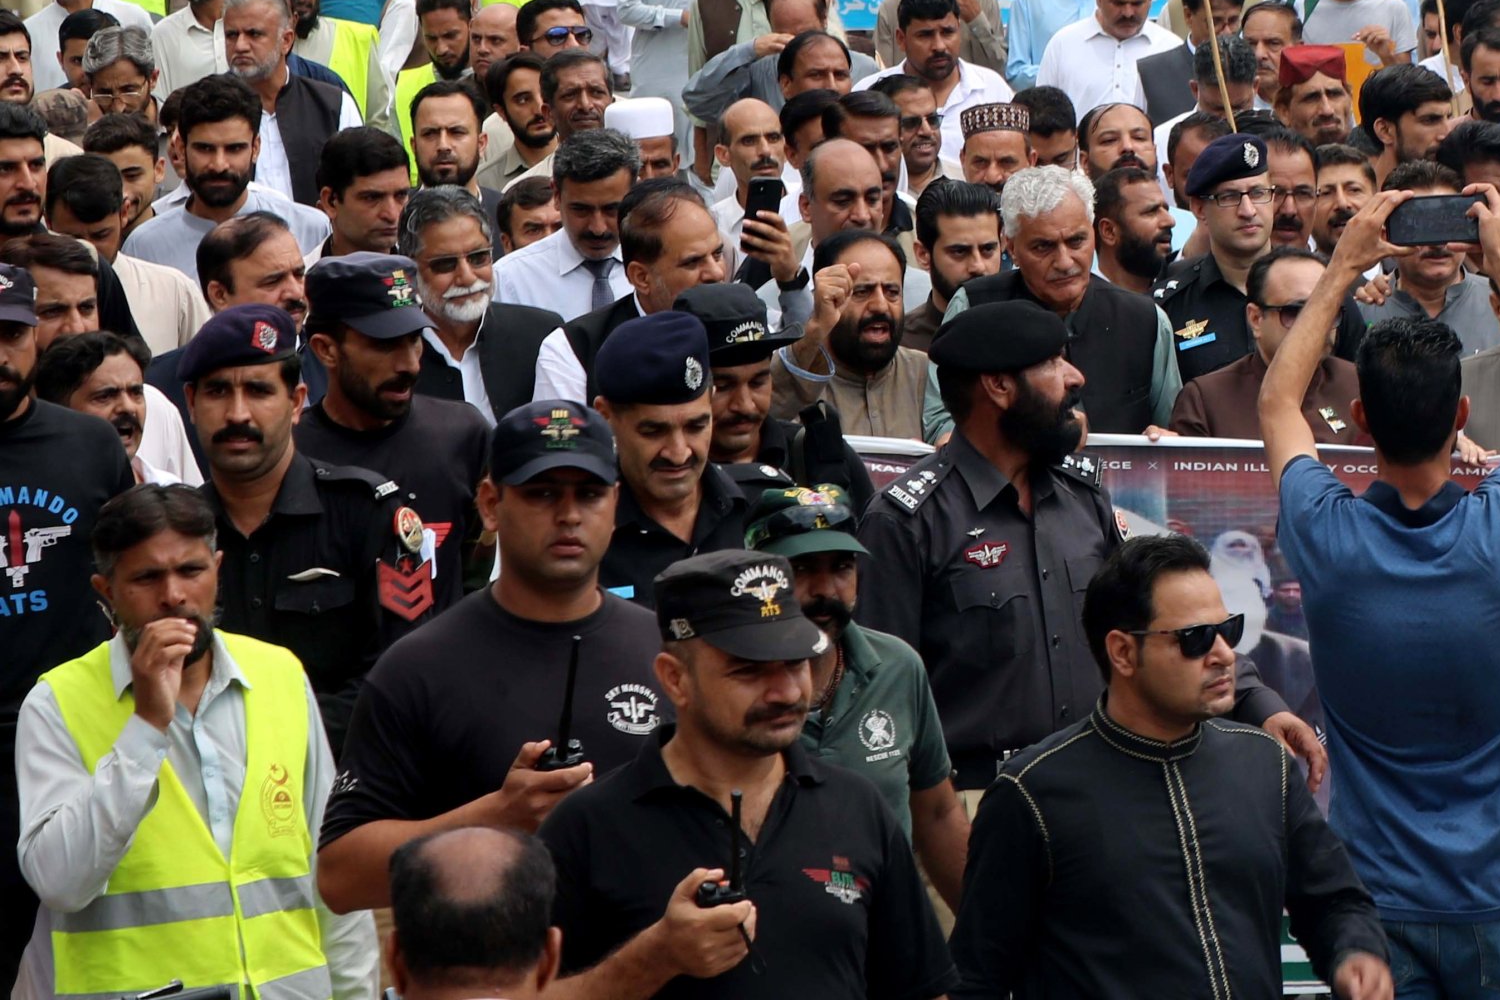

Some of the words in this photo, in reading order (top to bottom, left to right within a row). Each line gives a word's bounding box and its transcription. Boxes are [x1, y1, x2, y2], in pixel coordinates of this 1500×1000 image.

[1101, 460, 1132, 470] EGE
[1173, 460, 1239, 472] INDIAN
[0, 484, 79, 526] MANDO
[887, 484, 919, 510] POLICE
[730, 565, 789, 597] COMMANDO
[604, 686, 621, 702] SKY
[865, 752, 889, 763] RESCUE
